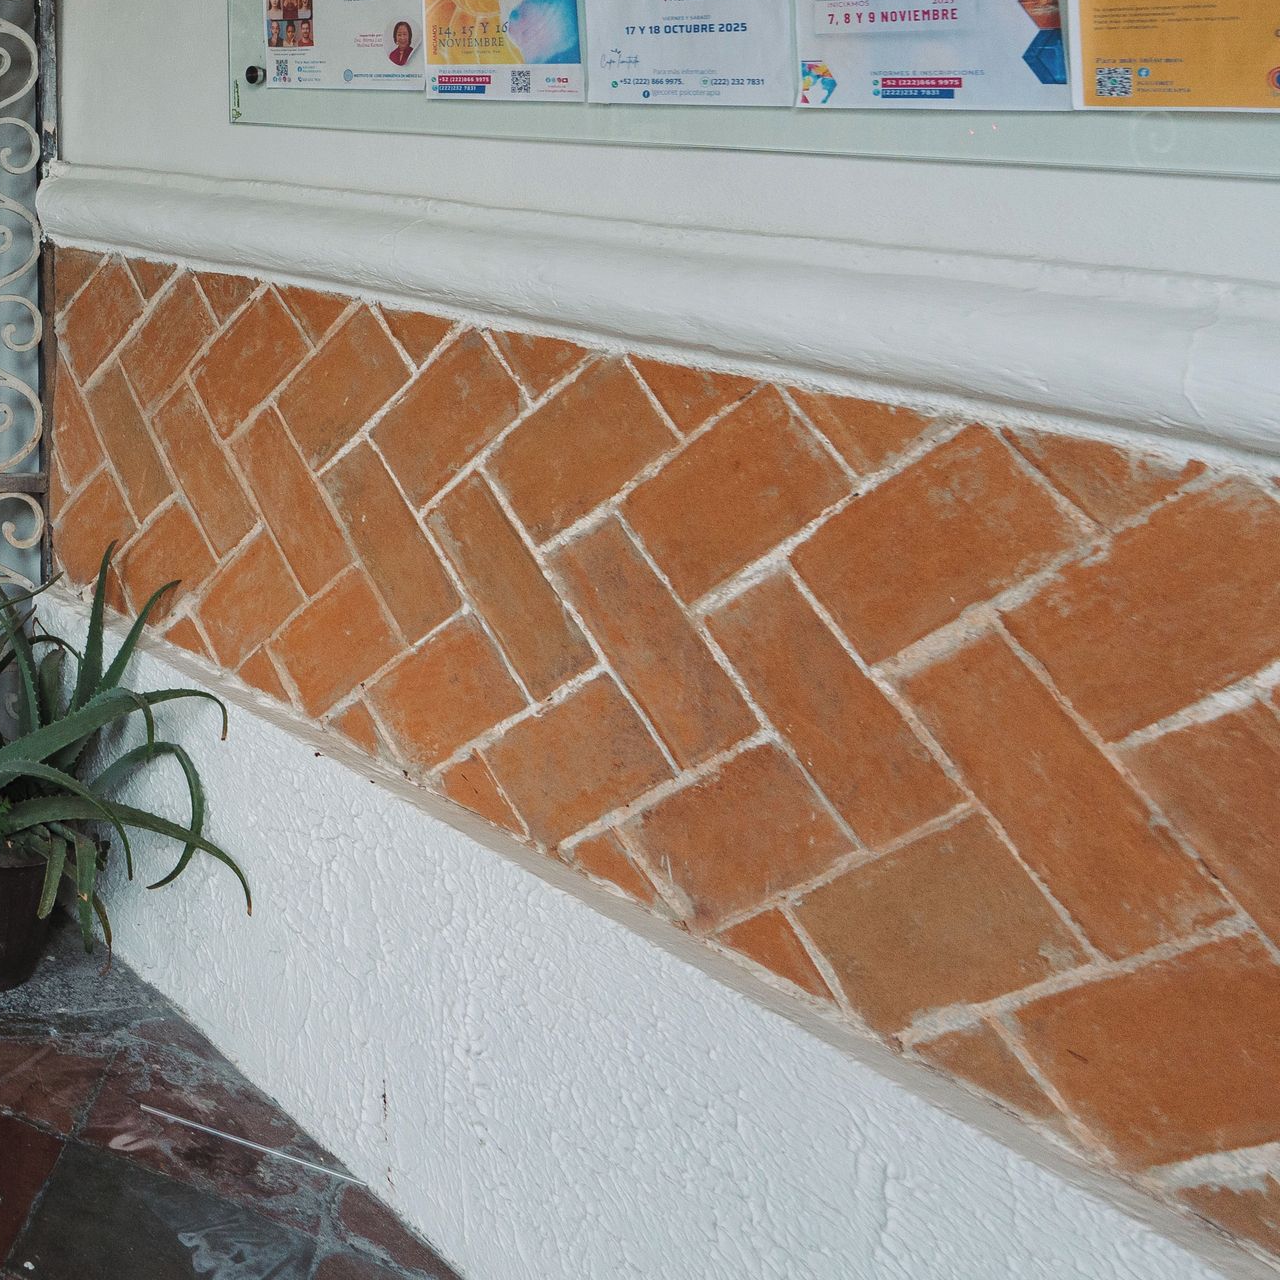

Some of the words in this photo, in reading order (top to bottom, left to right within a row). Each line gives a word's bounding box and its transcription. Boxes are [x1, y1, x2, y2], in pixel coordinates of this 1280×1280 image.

[827, 13, 839, 26] 7,
[843, 13, 851, 24] 8
[855, 12, 863, 24] Y
[868, 11, 876, 23] 9
[881, 8, 958, 23] NOVIEMBRE
[439, 26, 457, 37] 14,
[461, 25, 475, 36] 15
[479, 22, 489, 33] Y
[495, 21, 509, 33] 16
[625, 26, 635, 35] 17
[639, 25, 646, 34] Y
[649, 25, 661, 34] 18
[664, 23, 715, 33] OCTUBRE
[718, 22, 748, 32] 2025
[439, 36, 505, 48] NOVIEMBRE
[632, 78, 650, 86] (222)
[710, 78, 730, 86] (222)
[747, 78, 765, 86] 7831
